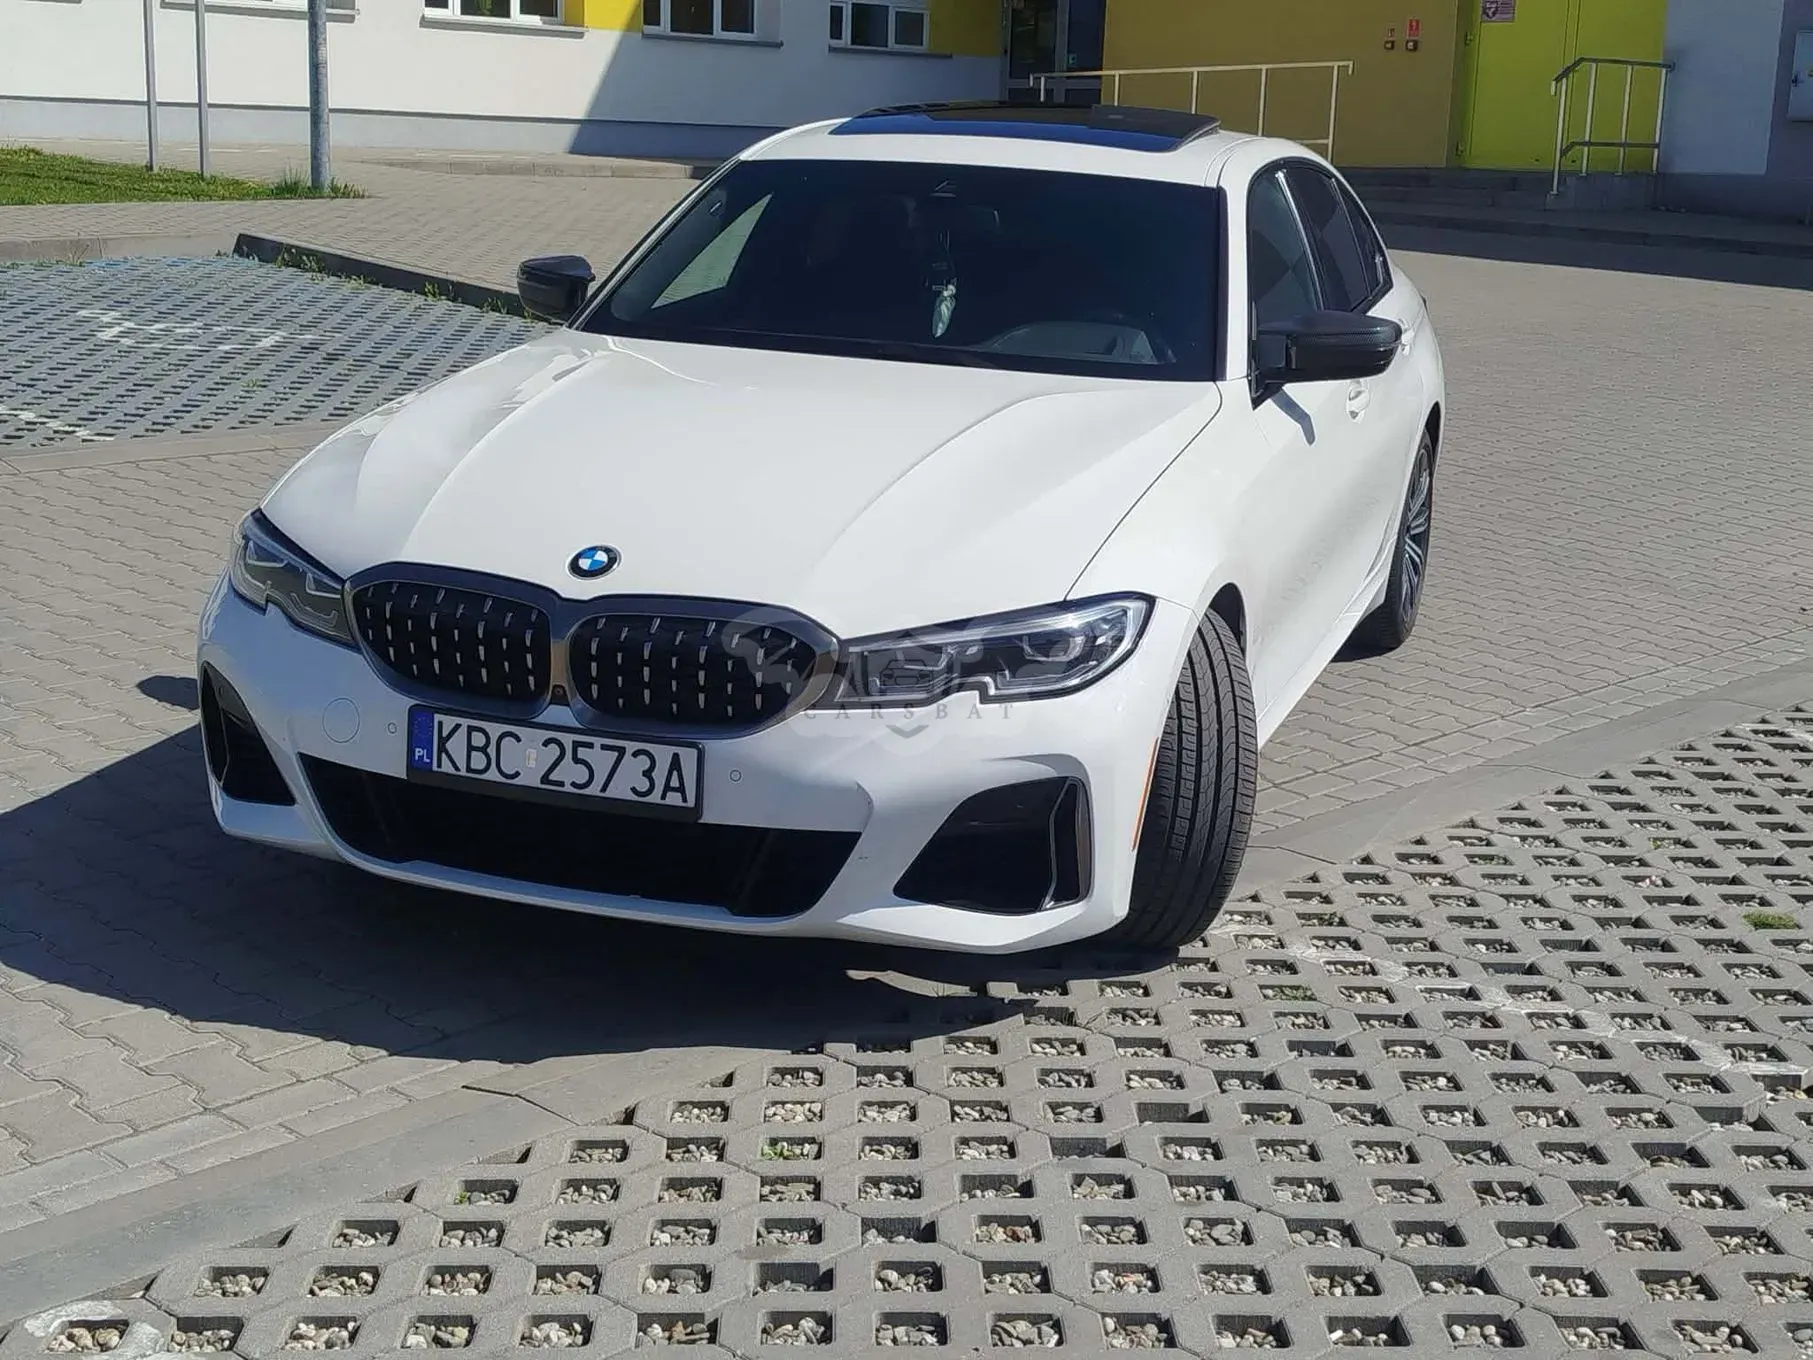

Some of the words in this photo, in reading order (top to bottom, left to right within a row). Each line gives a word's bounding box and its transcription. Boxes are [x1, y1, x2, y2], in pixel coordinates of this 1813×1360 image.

[415, 748, 431, 763] PL
[436, 721, 523, 780] KBC
[539, 737, 688, 804] 2573A
